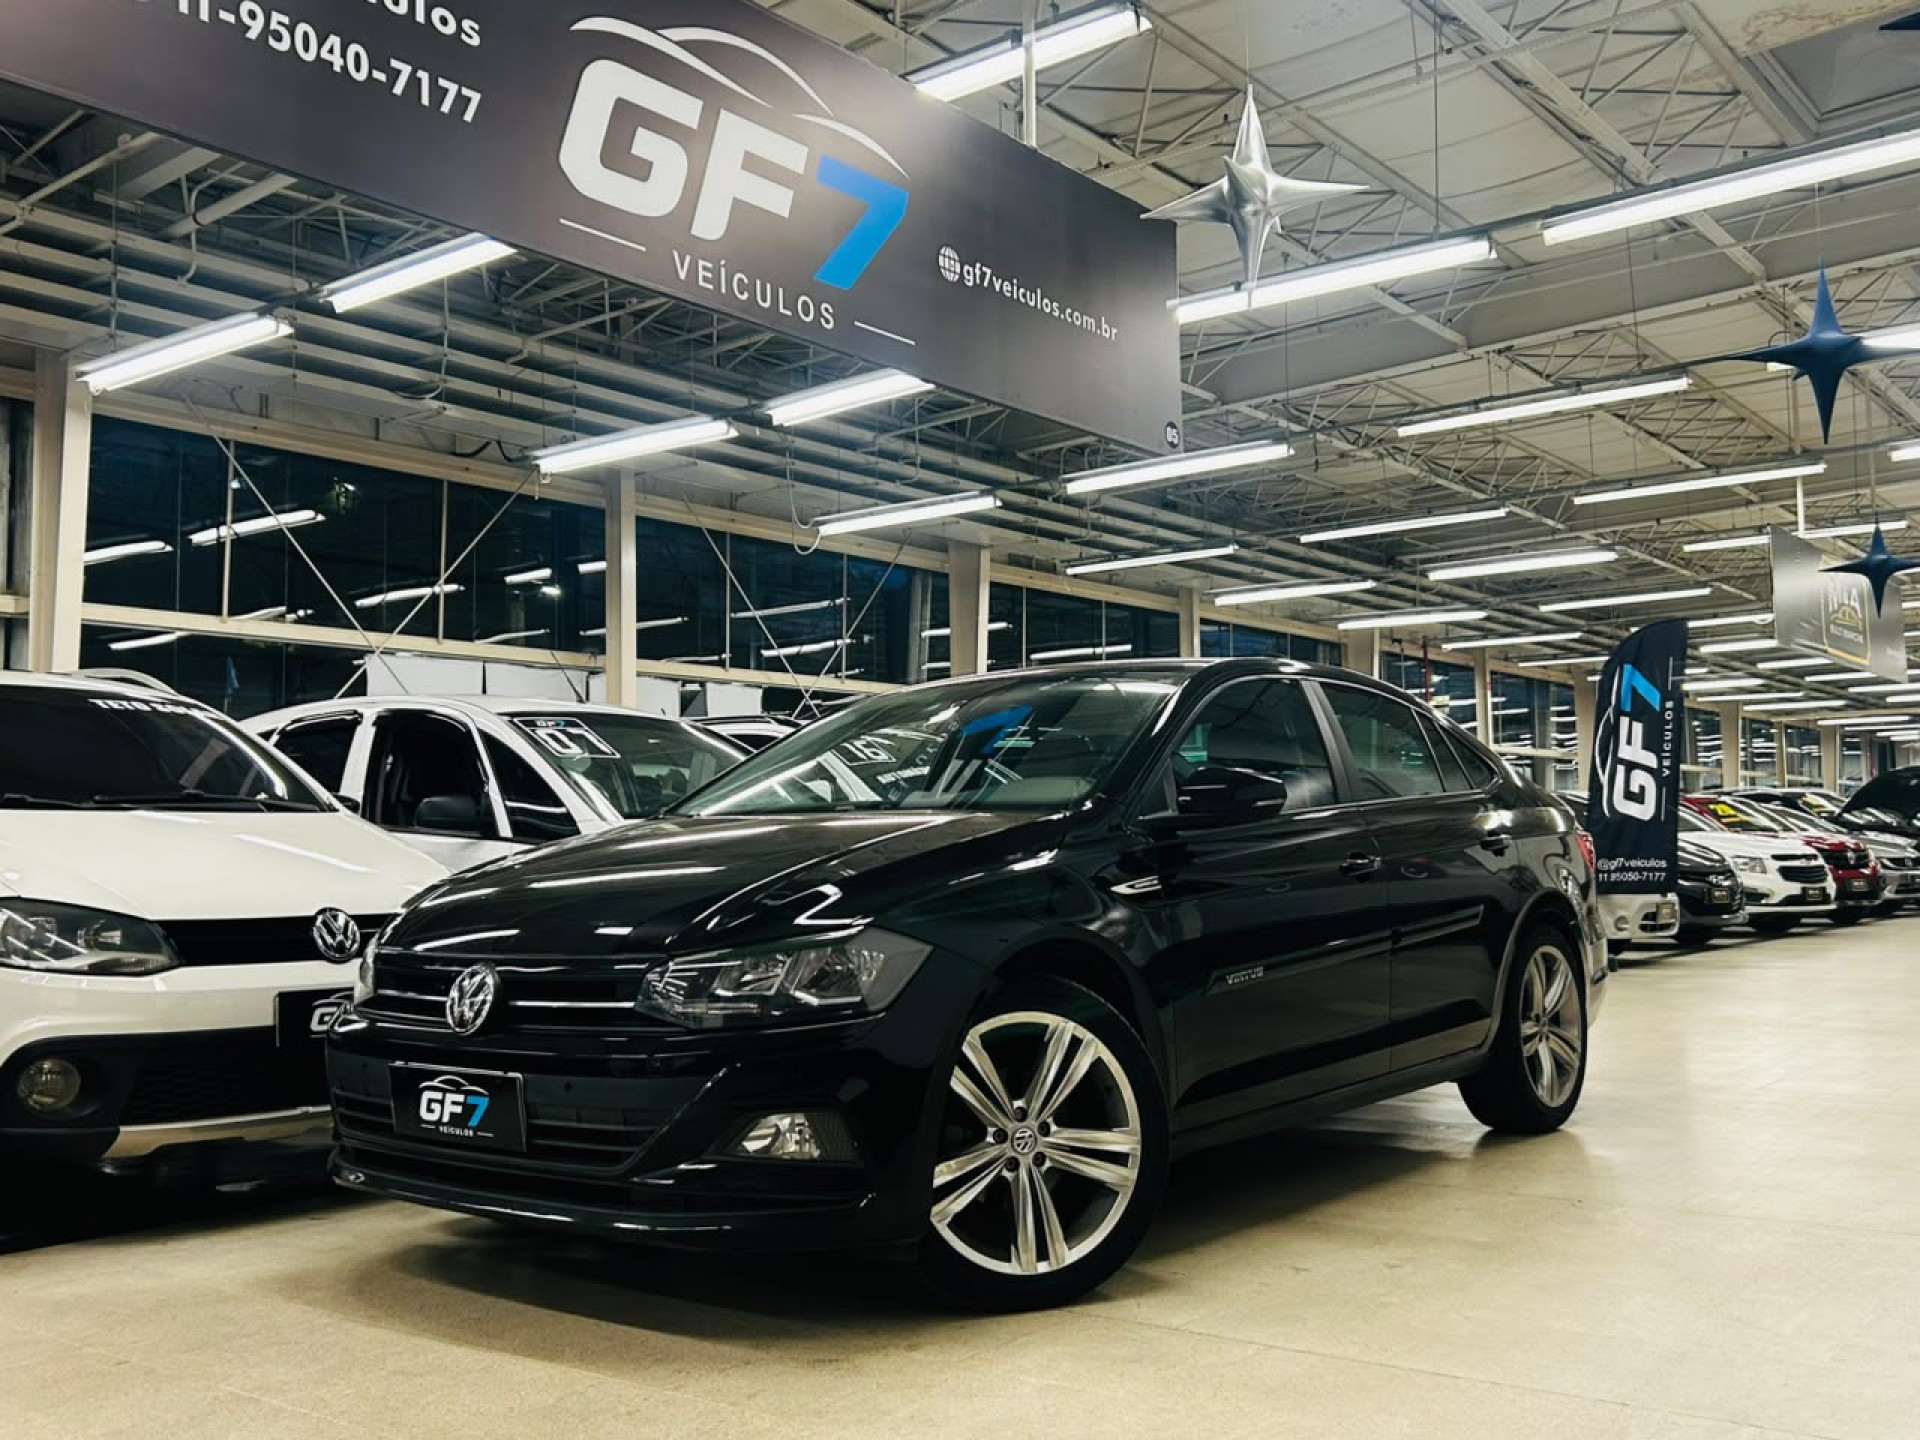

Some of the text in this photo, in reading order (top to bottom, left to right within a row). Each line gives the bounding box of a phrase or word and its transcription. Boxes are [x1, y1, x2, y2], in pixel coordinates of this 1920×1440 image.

[559, 58, 910, 292] GF7
[672, 250, 836, 330] VEÍCULOS
[962, 261, 1118, 341] gf7veiculos.com.br
[1166, 425, 1180, 445] 05
[1613, 663, 1662, 821] GF7
[419, 1091, 490, 1128] GF7
